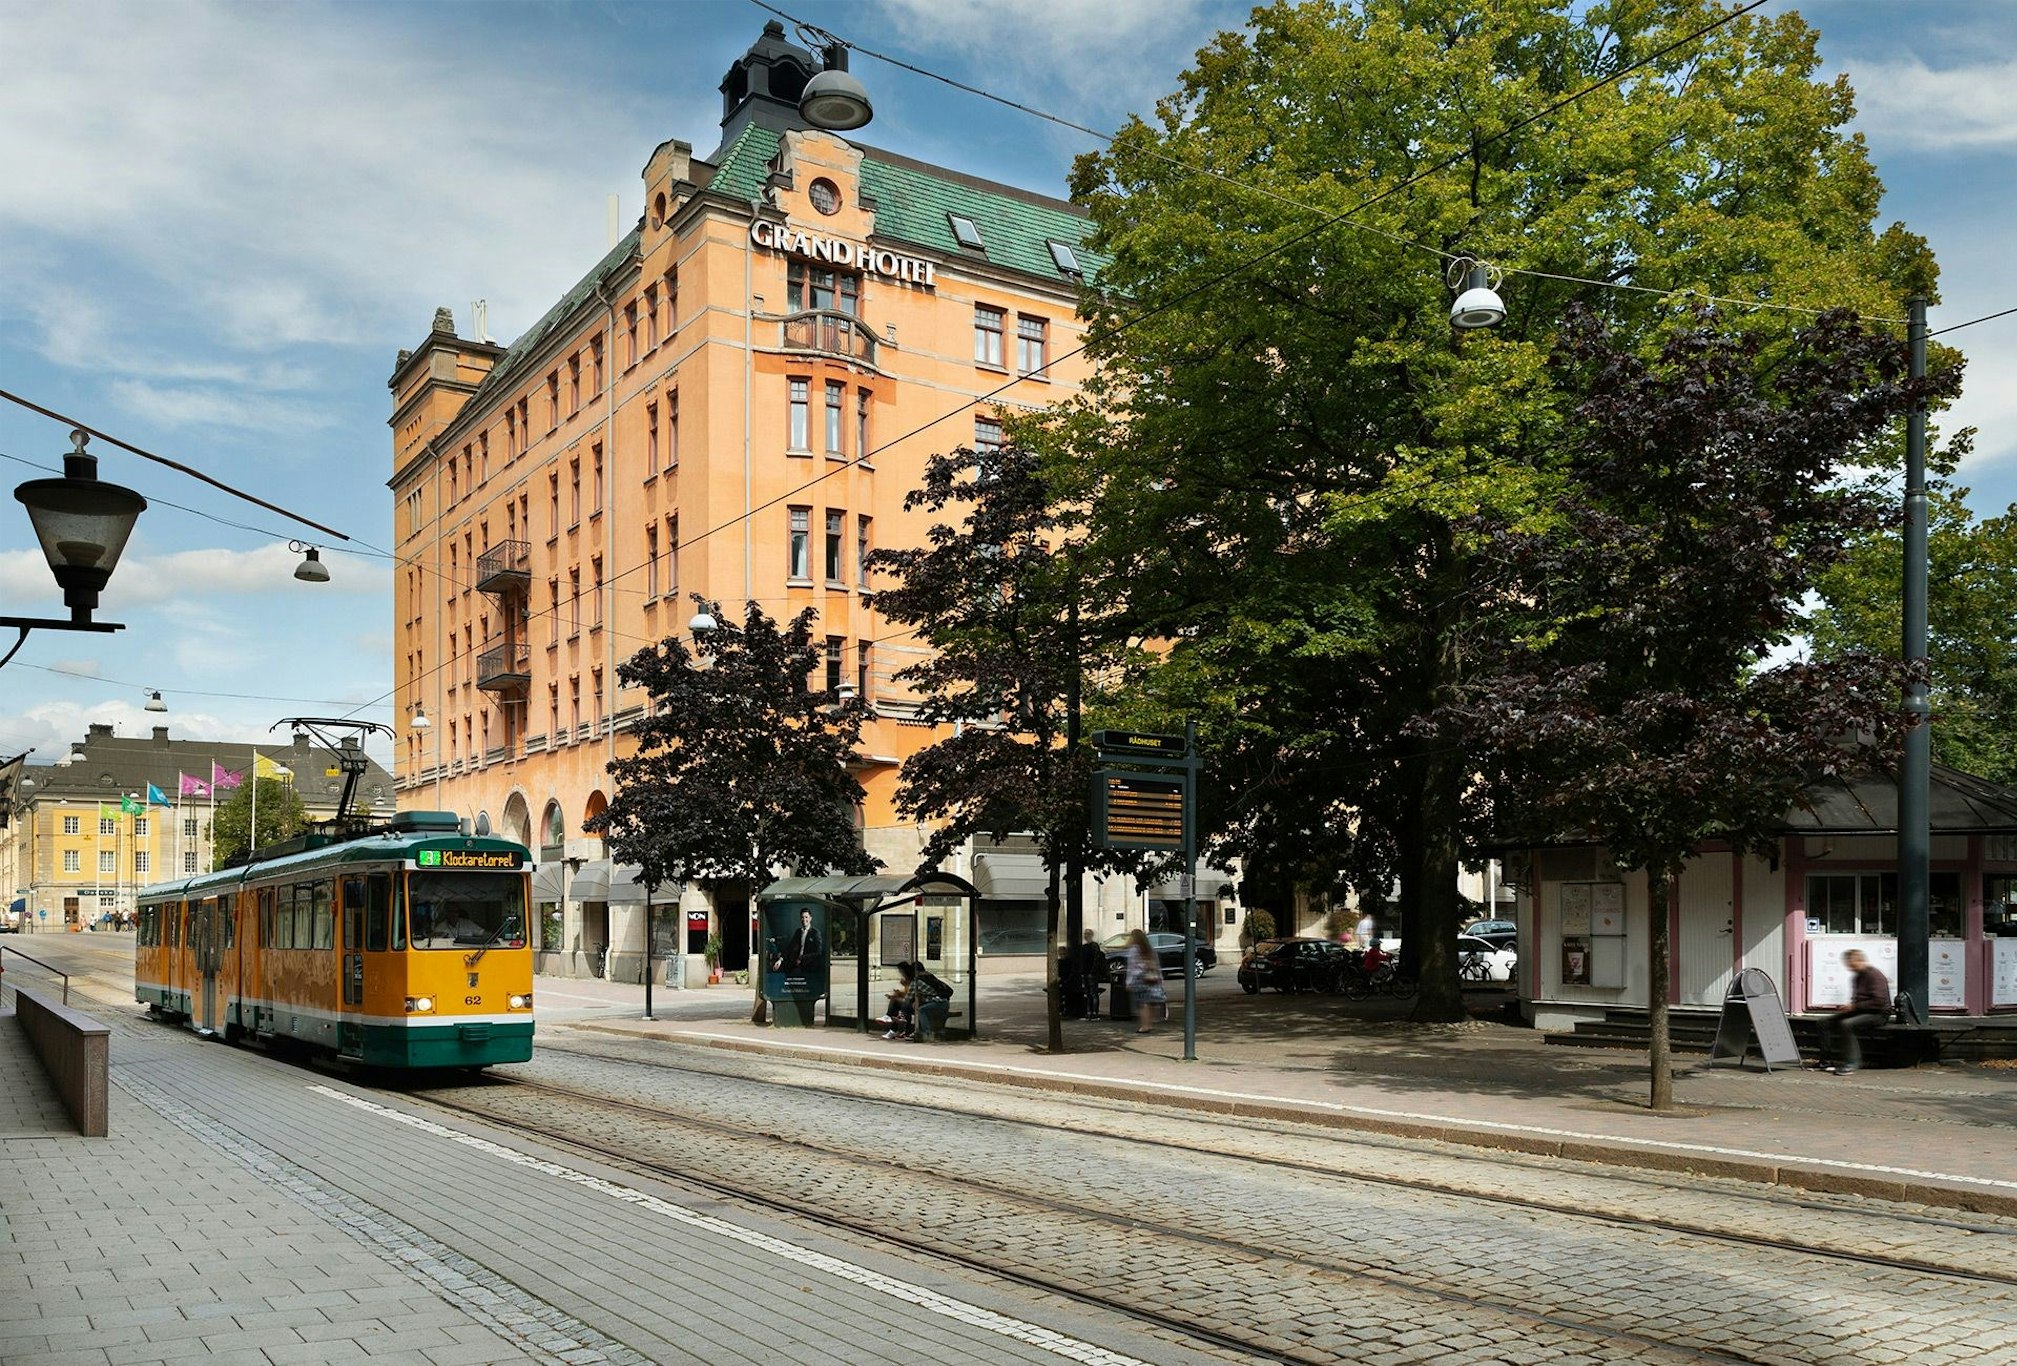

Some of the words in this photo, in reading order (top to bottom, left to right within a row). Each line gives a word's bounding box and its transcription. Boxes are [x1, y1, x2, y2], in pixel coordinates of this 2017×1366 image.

[751, 220, 853, 264] GRAND
[856, 245, 936, 286] HOTEL
[442, 851, 515, 867] Klockaretorpet
[465, 995, 482, 1006] 62
